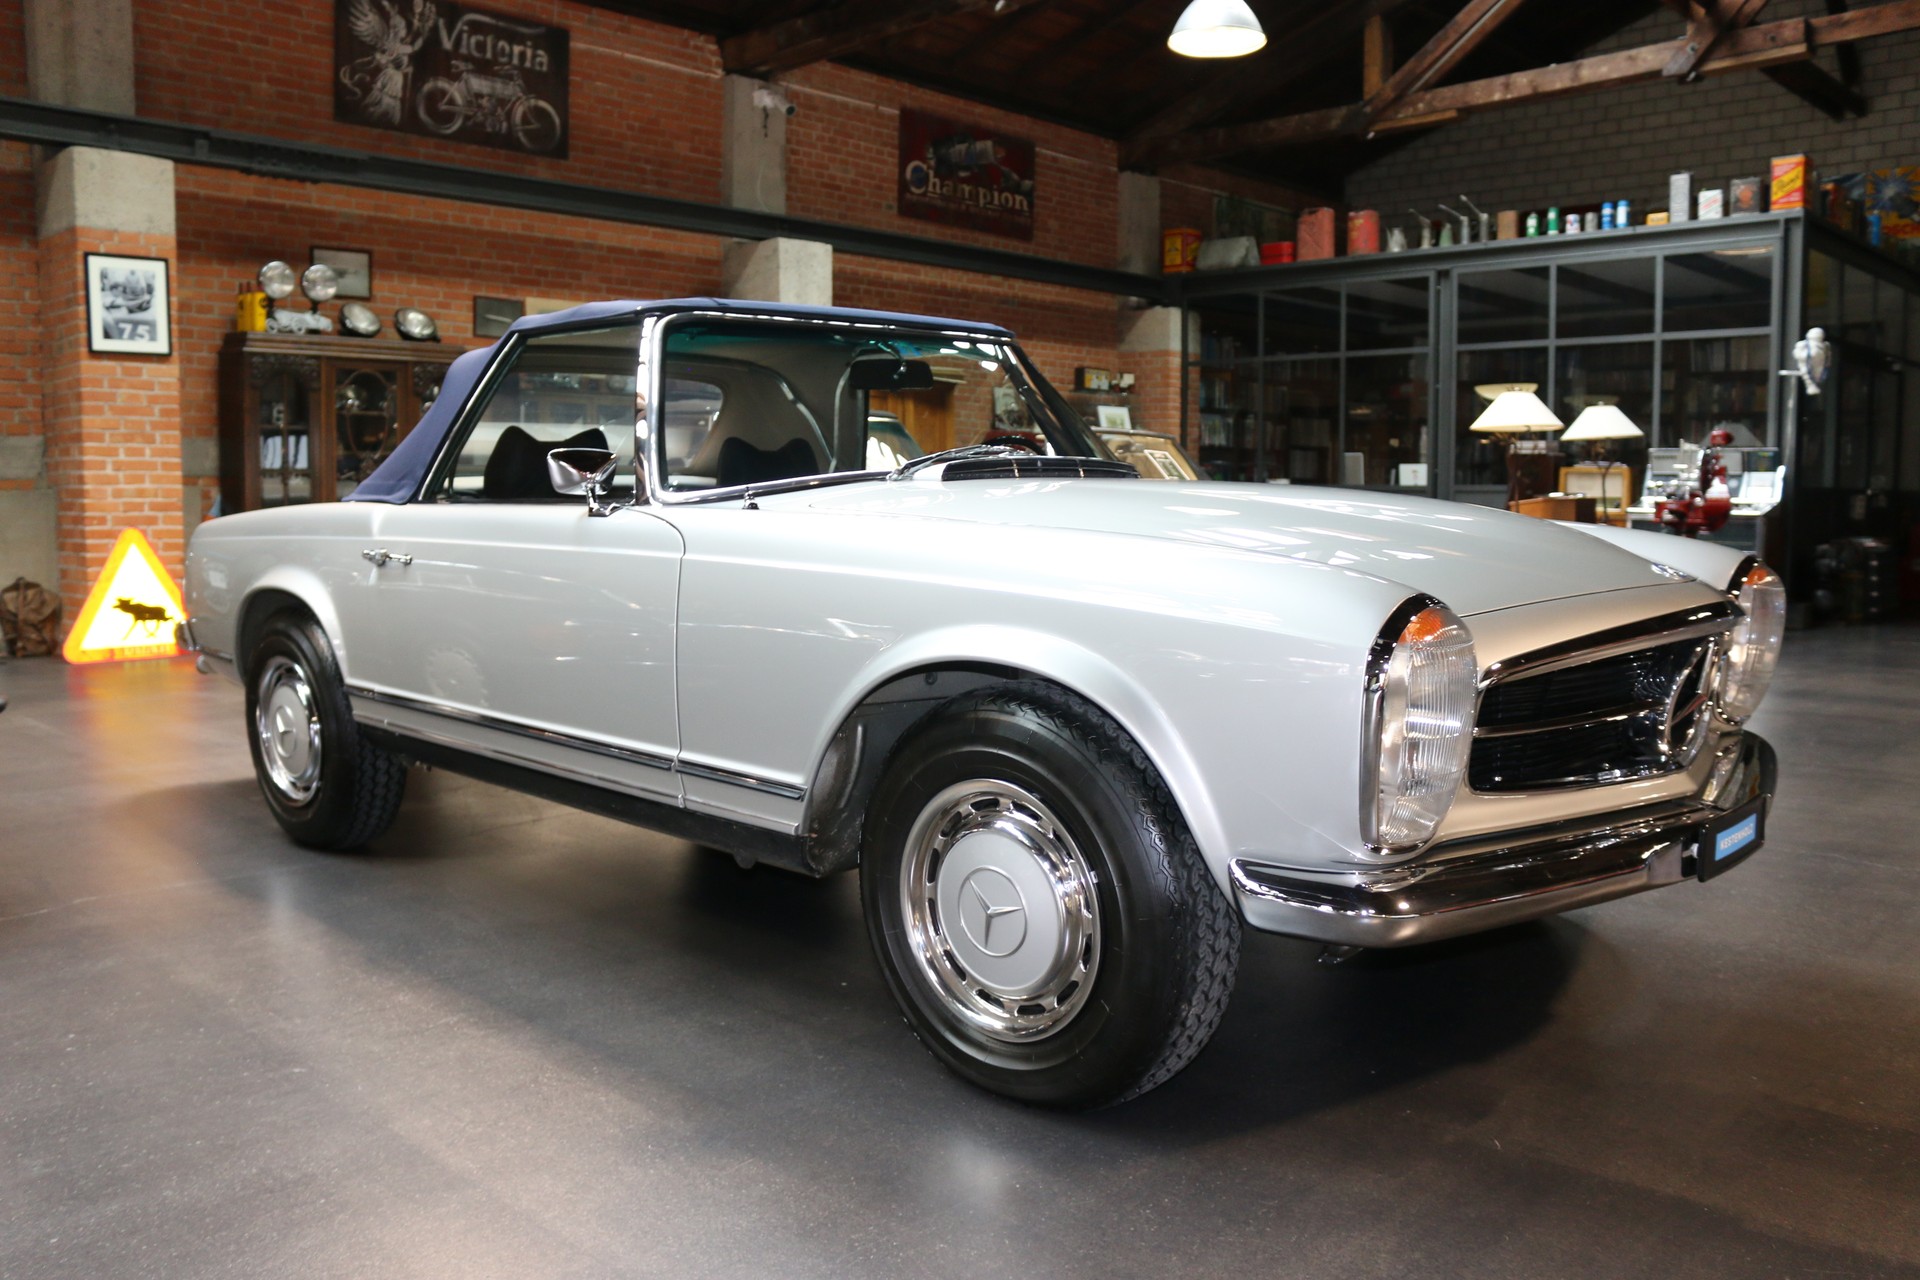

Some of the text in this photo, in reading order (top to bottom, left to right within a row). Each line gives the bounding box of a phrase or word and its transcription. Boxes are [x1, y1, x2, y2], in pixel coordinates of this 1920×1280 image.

[438, 13, 549, 72] Victoria
[905, 160, 1030, 212] Champion
[118, 322, 150, 341] 75
